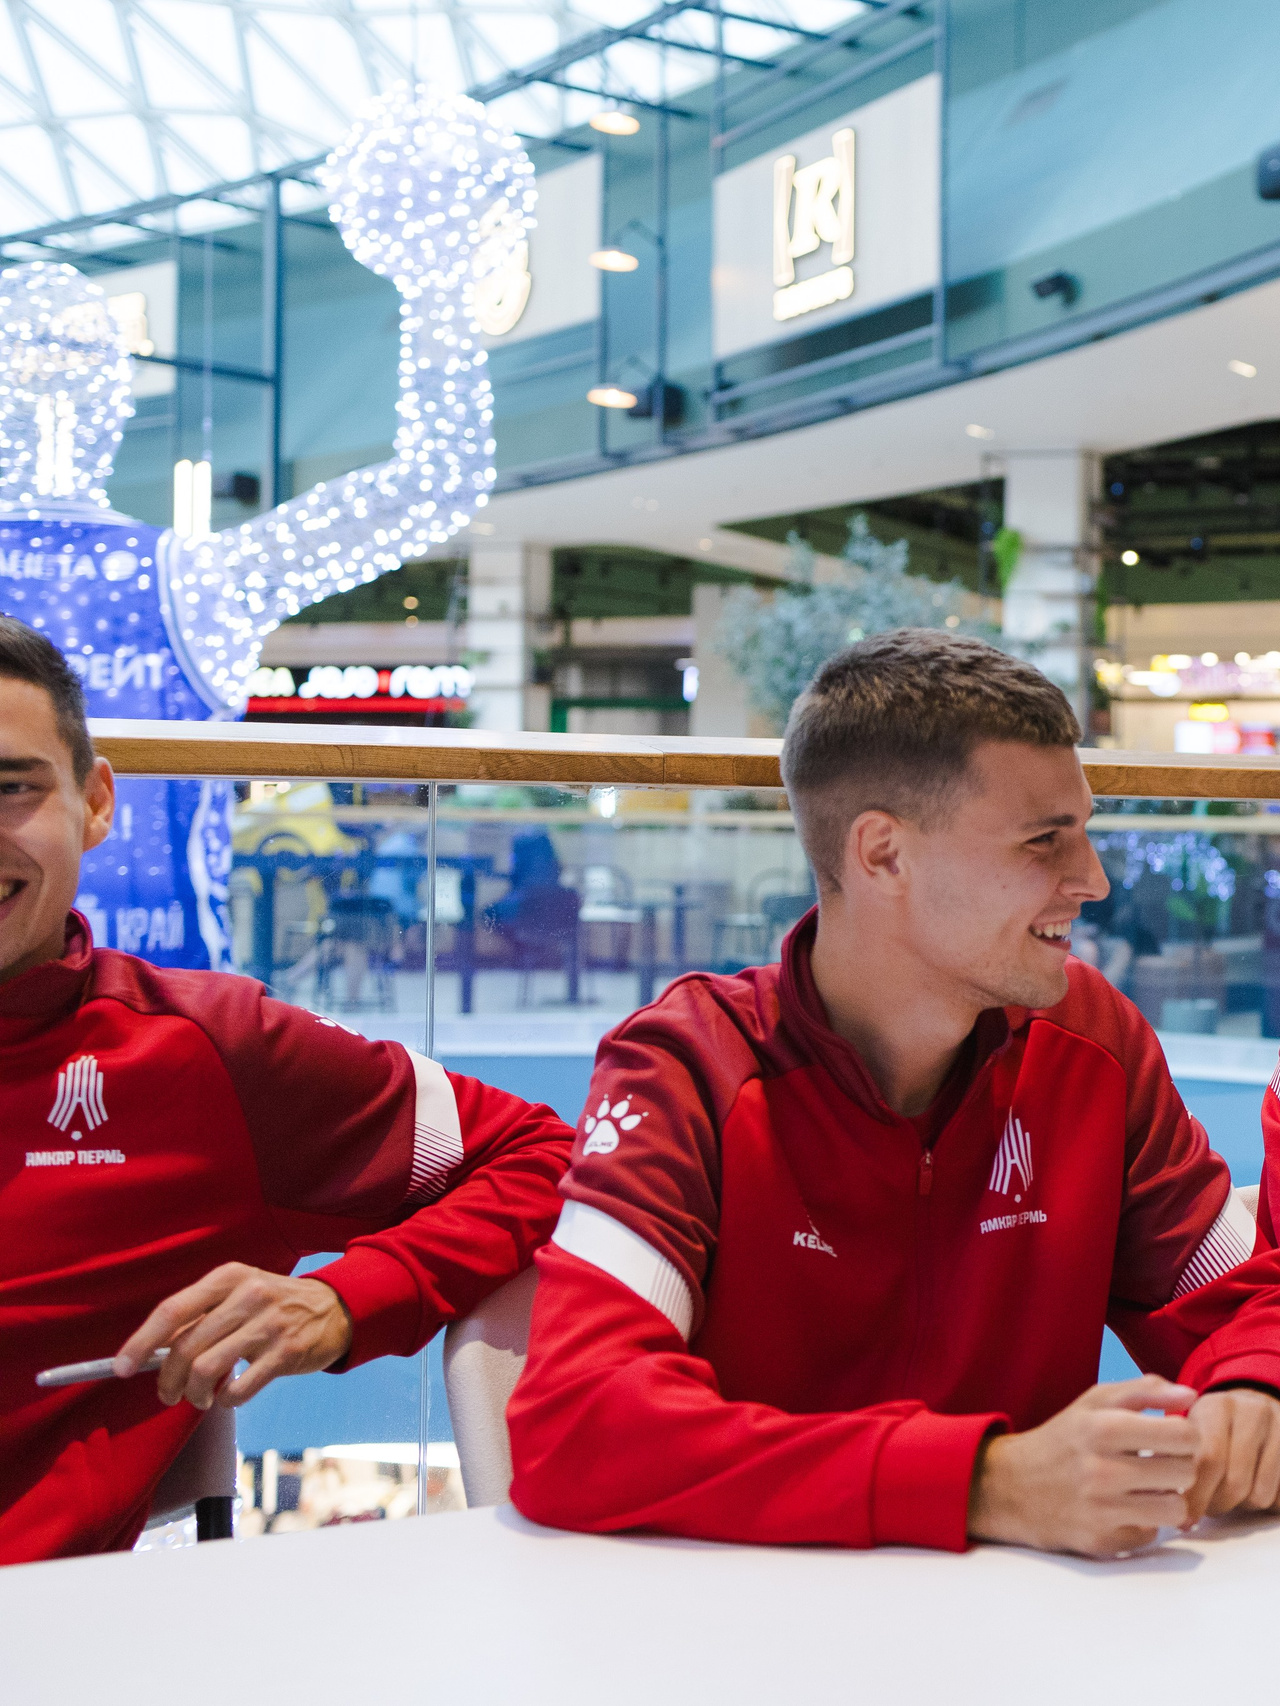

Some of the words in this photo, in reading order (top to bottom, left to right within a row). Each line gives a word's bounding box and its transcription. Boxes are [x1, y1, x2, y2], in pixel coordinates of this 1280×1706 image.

[25, 1151, 75, 1167] АМКАР
[77, 1149, 126, 1164] ПЕРМЬ
[1017, 1209, 1048, 1226] ЕРМЬ
